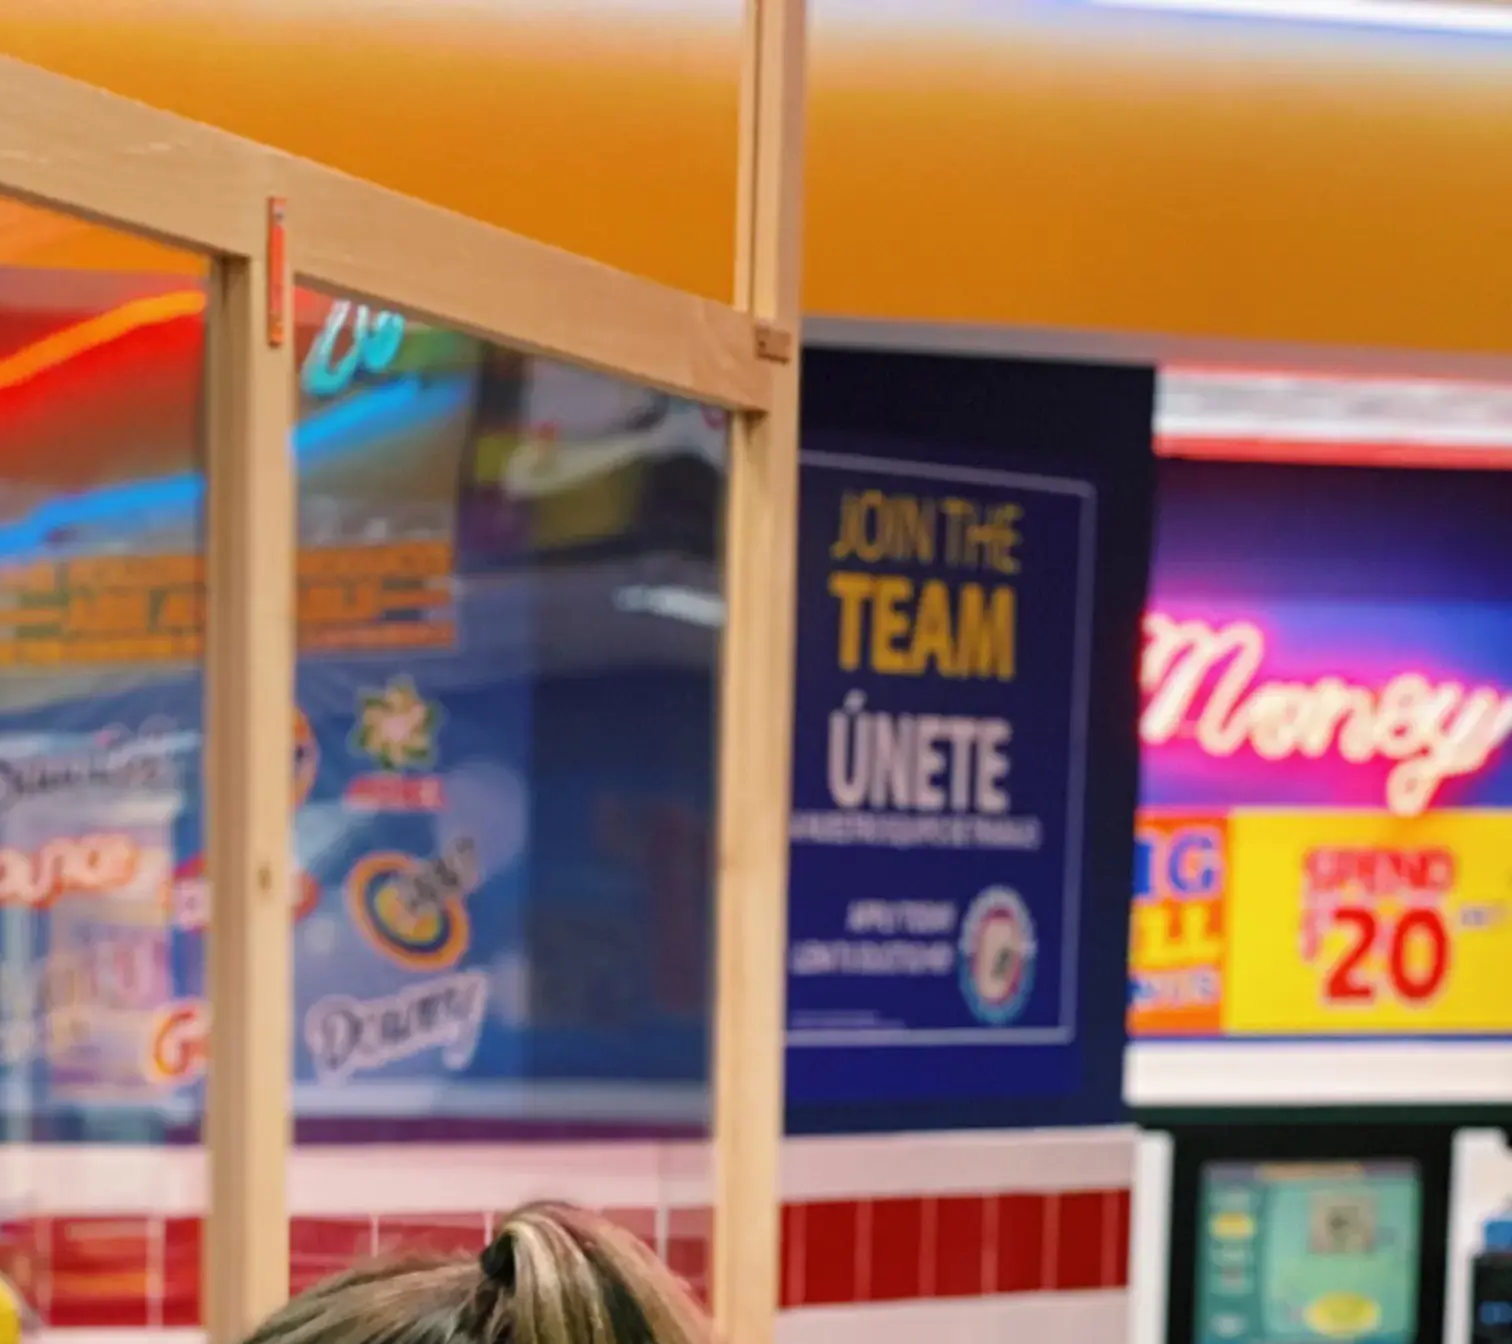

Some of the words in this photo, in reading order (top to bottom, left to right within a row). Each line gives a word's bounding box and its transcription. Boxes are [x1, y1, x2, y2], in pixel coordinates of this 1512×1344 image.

[831, 490, 931, 563] JOIN
[938, 496, 1023, 575] THE
[828, 571, 1016, 681] TEAM
[827, 687, 1012, 815] ÚNETE
[1139, 612, 1512, 817] Money
